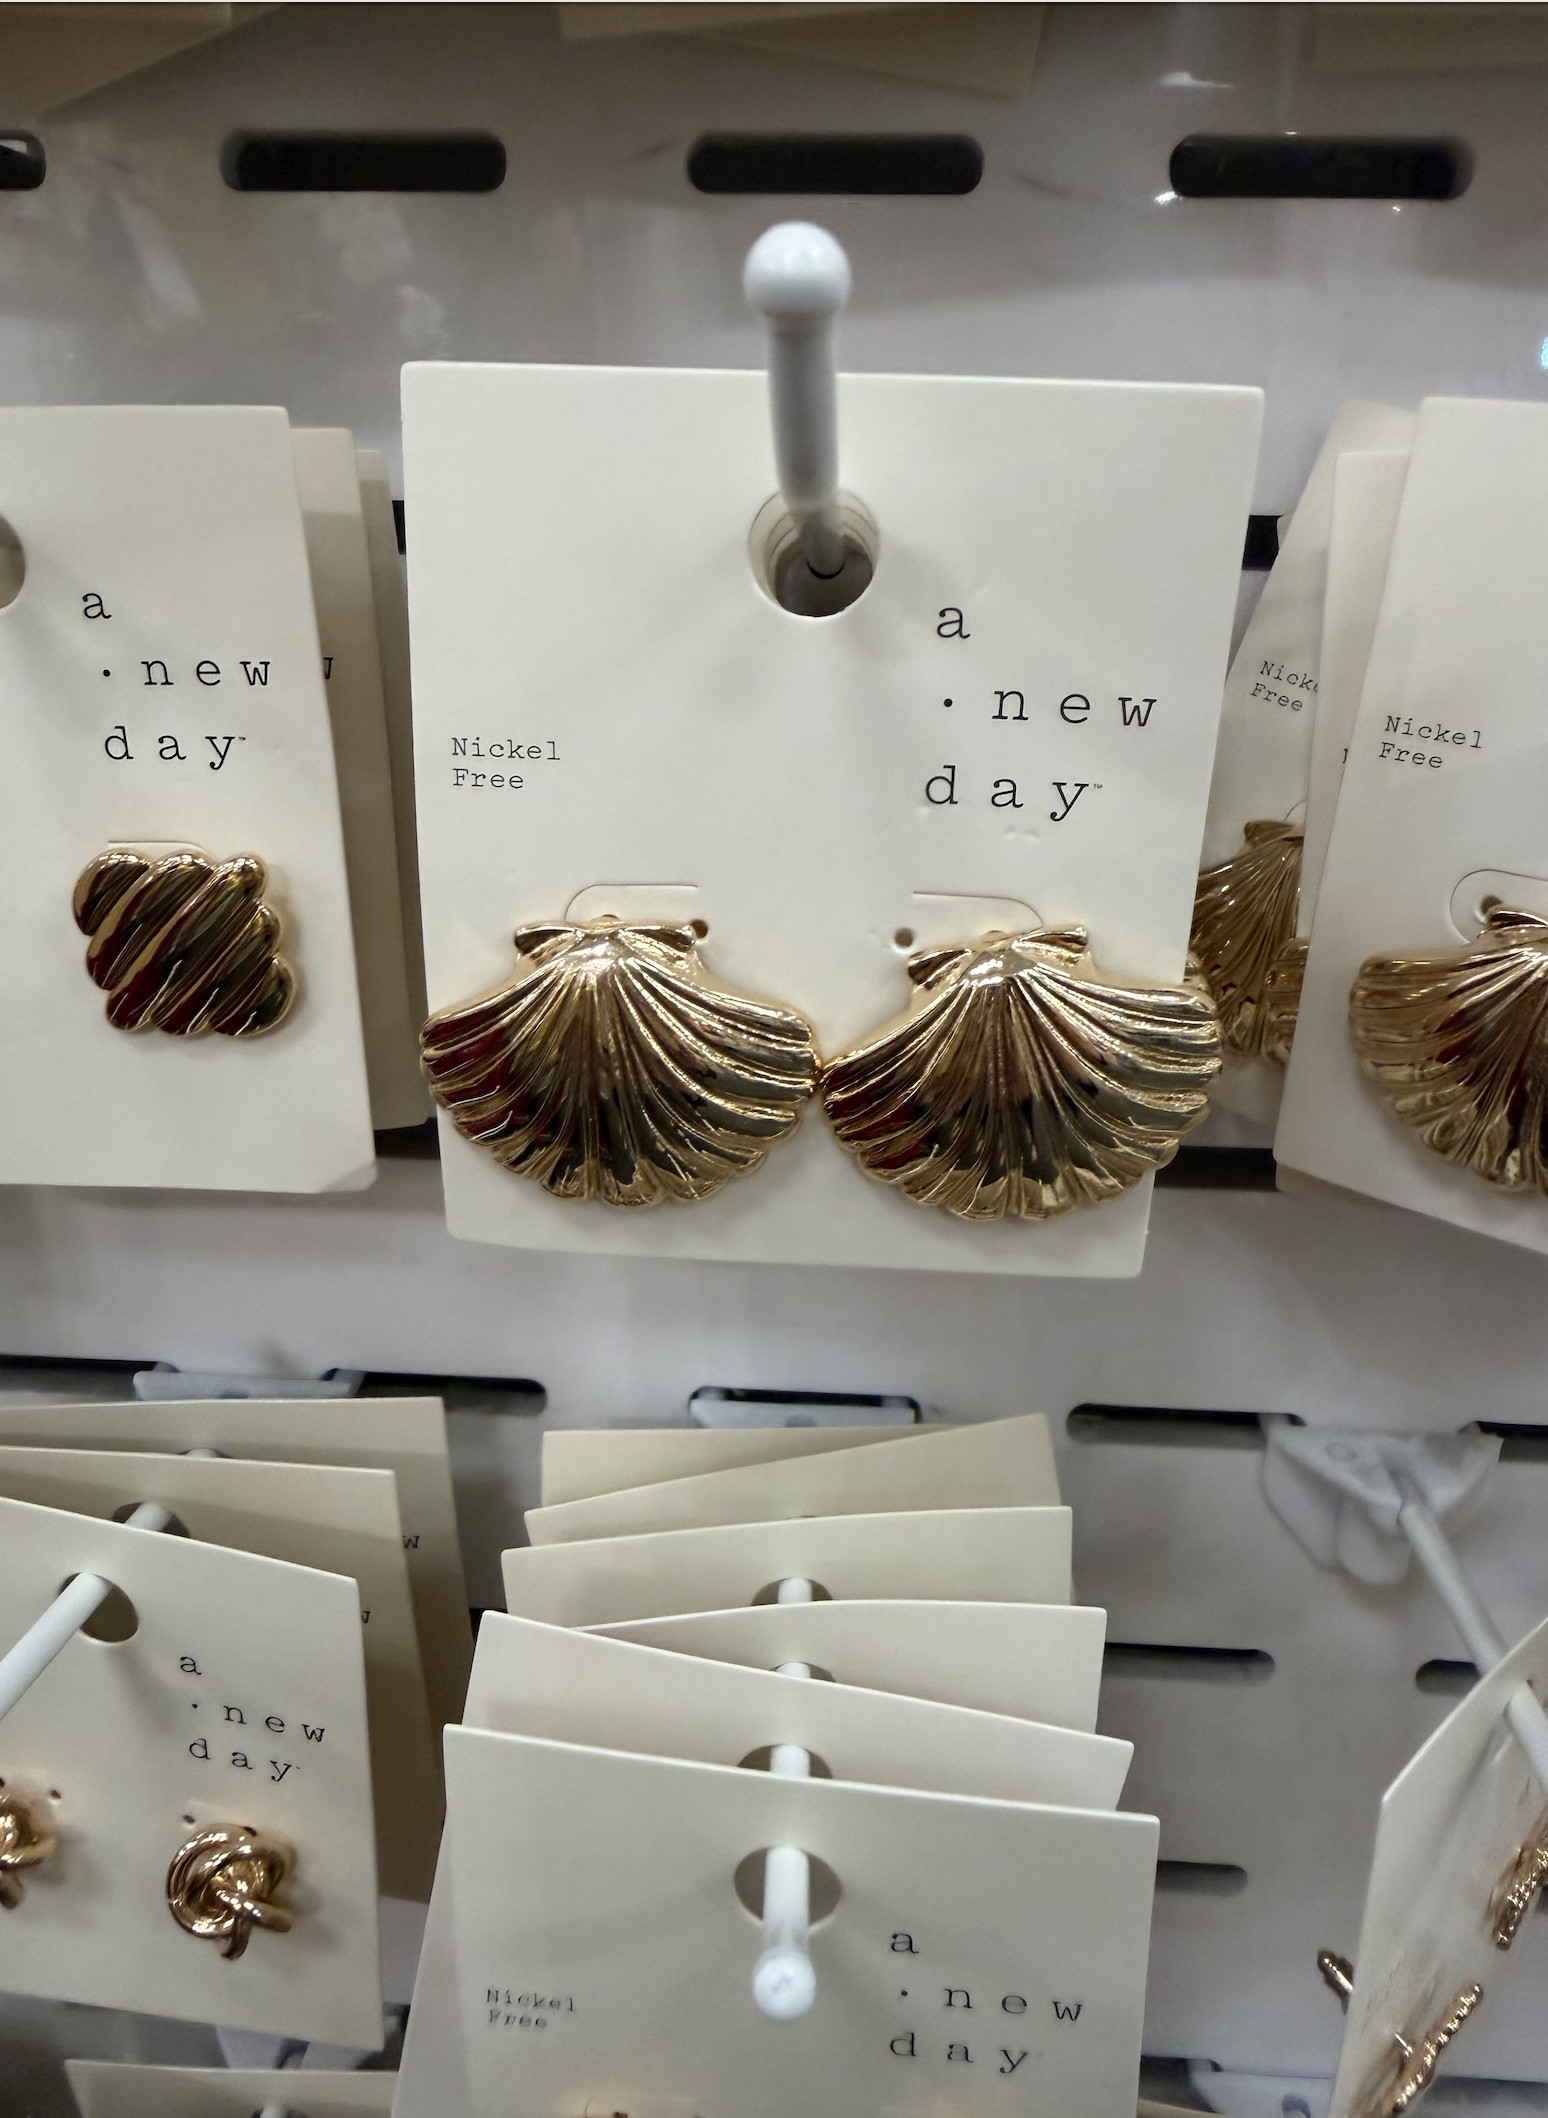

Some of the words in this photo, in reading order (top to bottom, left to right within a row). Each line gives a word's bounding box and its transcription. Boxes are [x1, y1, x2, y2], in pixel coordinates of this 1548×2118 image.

[82, 592, 112, 620] a
[936, 607, 971, 639] a
[1250, 682, 1303, 712] Free
[1384, 715, 1483, 749] Nickel
[451, 736, 561, 760] Nickel
[1378, 741, 1443, 769] Free
[452, 767, 524, 789] Free
[179, 1655, 202, 1675] a
[890, 1932, 919, 1954] a
[890, 2032, 1028, 2074] day
